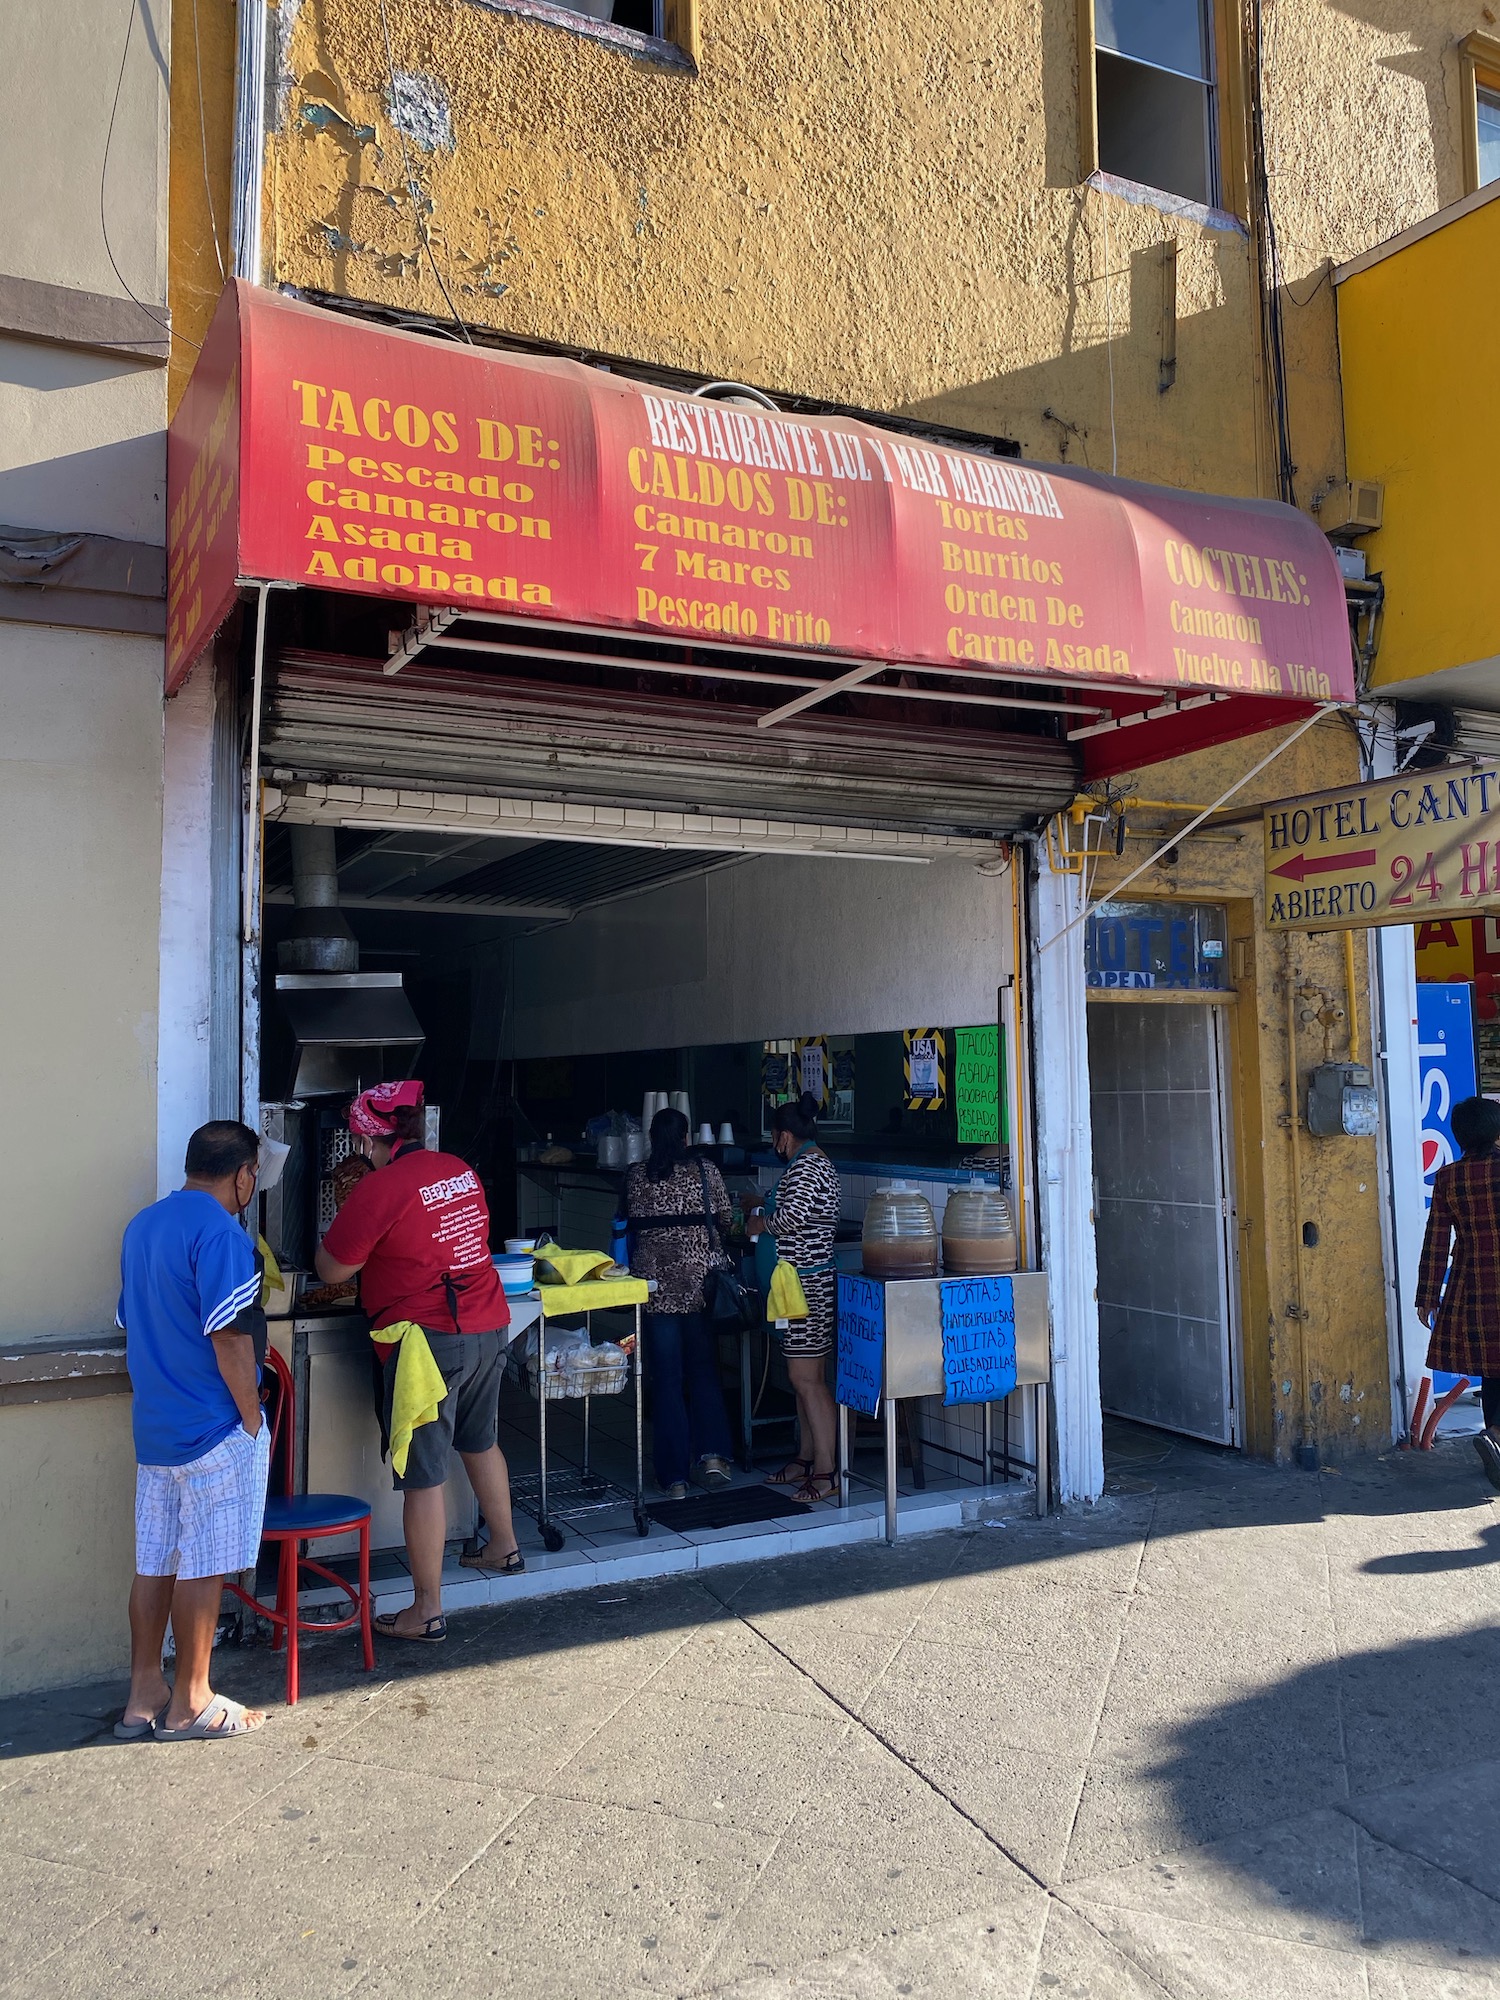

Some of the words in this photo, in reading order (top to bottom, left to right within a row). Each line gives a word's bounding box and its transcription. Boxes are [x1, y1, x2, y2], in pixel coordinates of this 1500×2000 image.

[292, 379, 461, 455] TACOS
[476, 417, 562, 470] DE:
[304, 443, 534, 504] Pescado
[641, 393, 823, 478] RESTAURANTE
[820, 429, 872, 482] LUZ
[866, 437, 893, 483] Y
[897, 442, 949, 499] MAR
[942, 451, 1064, 520] MARINERA
[304, 479, 553, 541] Camaron
[627, 445, 777, 518] CALDOS
[784, 475, 849, 529] DE:
[304, 514, 474, 562] Asada
[633, 503, 815, 560] Camaron
[934, 500, 1029, 542] Tortas
[304, 549, 553, 607] Adobada
[634, 542, 659, 572] 7
[674, 551, 792, 593] Mares
[940, 541, 1064, 587] Burritos
[1163, 537, 1311, 607] COCTELES:
[635, 585, 759, 639] Pescado
[766, 606, 832, 646] Frito
[944, 582, 1037, 624] Orden
[1044, 595, 1085, 630] De
[1169, 599, 1263, 646] Camaron
[946, 626, 1035, 665] Carne
[1044, 637, 1130, 676] Asada
[1172, 647, 1245, 690] Vuelve
[1249, 659, 1282, 695] Ala
[1286, 662, 1332, 701] Vida
[1270, 797, 1381, 851] HOTEL
[1390, 771, 1500, 831] CANT
[1269, 880, 1377, 924] ABIERTO
[1389, 851, 1444, 909] 24
[1087, 971, 1152, 988] OPEN
[913, 1040, 933, 1056] USA
[957, 1031, 999, 1058] TACOS:
[957, 1062, 996, 1084] ASADA
[958, 1107, 997, 1126] PESCADO
[959, 1126, 999, 1143] CAMARÓ
[421, 1171, 477, 1204] GEPPETTO'S
[839, 1276, 881, 1311] TORTAS
[945, 1281, 1000, 1307] TORTAS
[946, 1309, 1015, 1330] HAMBURGUESAS
[839, 1335, 854, 1355] SAS
[947, 1354, 1016, 1375] QUESADILLAS
[838, 1356, 875, 1388] MULITAS
[950, 1374, 995, 1398] TACOS
